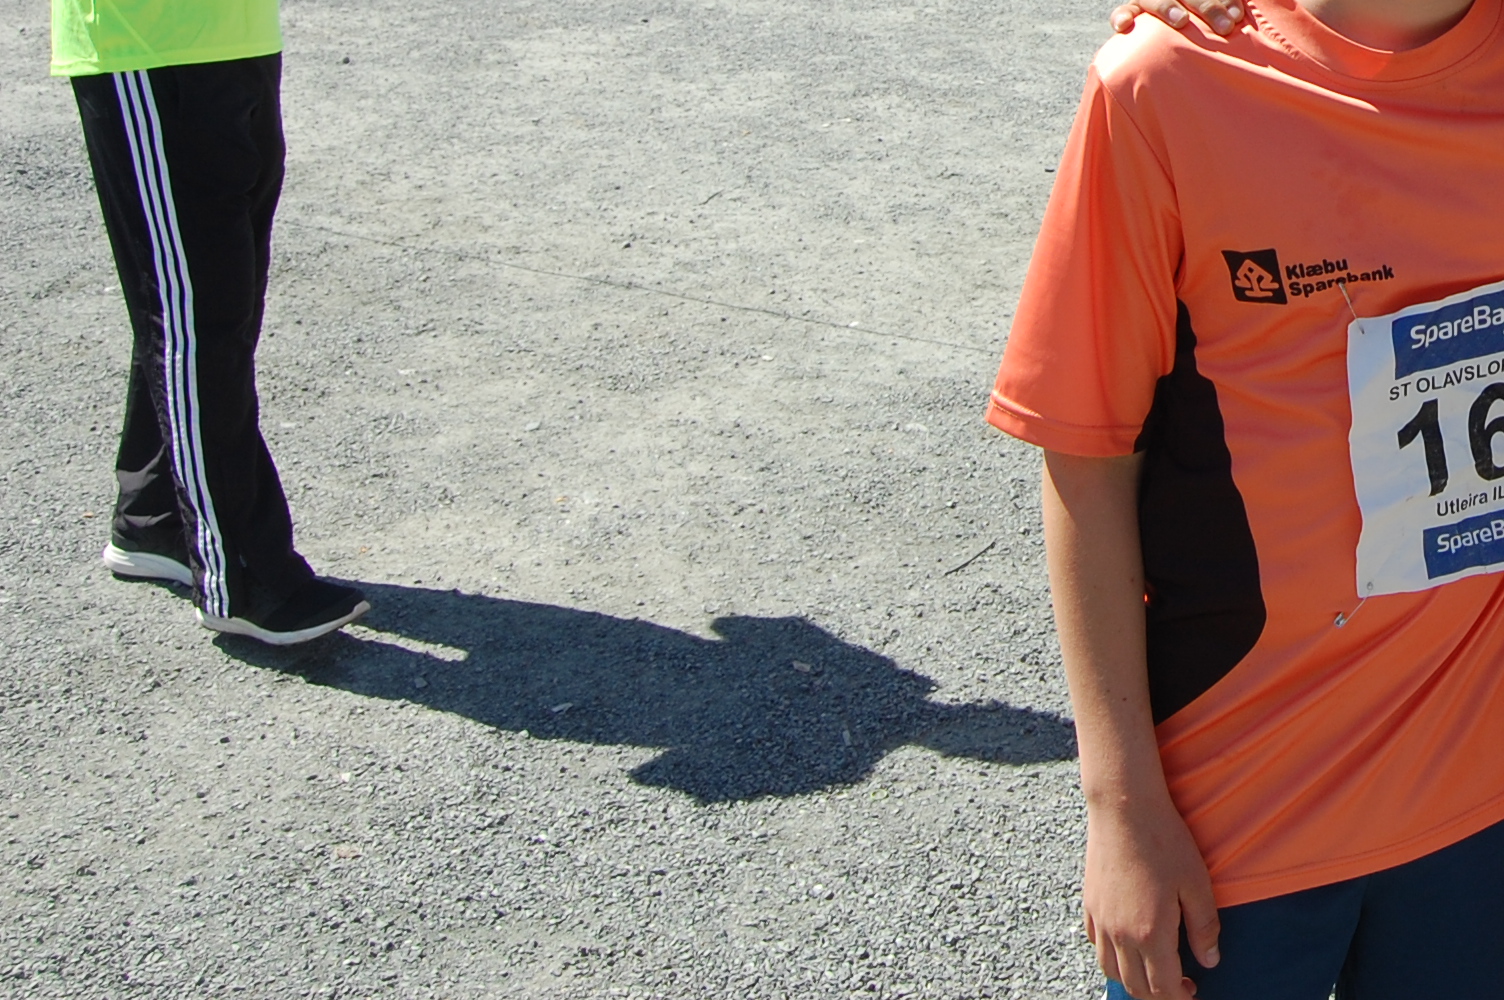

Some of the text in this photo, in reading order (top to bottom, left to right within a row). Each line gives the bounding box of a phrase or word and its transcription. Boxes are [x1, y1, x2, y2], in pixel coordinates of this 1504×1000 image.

[1285, 258, 1349, 281] Klæbu
[1288, 264, 1395, 298] Sparebank
[1389, 381, 1411, 402] ST
[1436, 492, 1489, 517] Utleira
